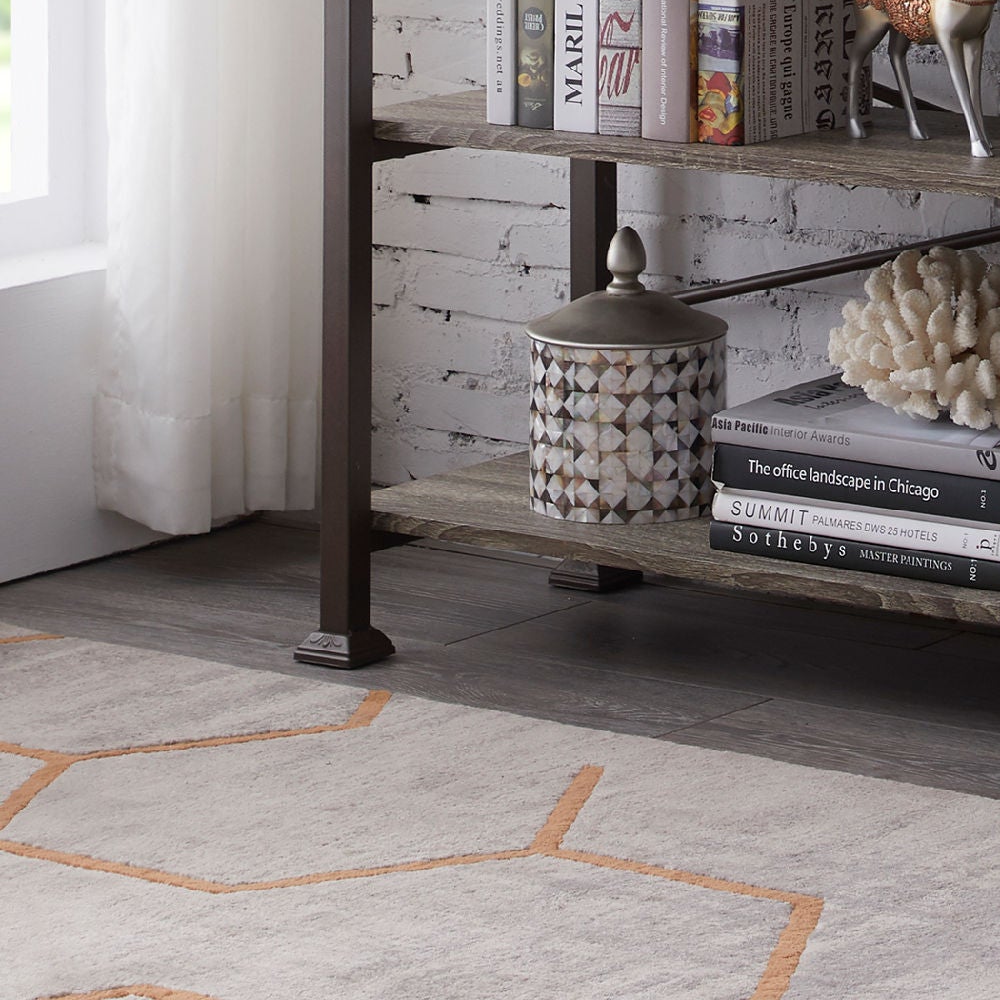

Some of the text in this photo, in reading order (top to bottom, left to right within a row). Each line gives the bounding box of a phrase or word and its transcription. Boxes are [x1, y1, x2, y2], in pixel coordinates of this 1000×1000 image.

[660, 28, 668, 56] Review
[660, 58, 668, 68] of
[780, 57, 796, 77] qui
[659, 97, 667, 125] Design
[780, 81, 794, 121] gagne
[711, 417, 851, 446] Asia Pacific Interior Awards
[748, 459, 939, 501] The office landscape in Chicago
[730, 500, 938, 542] SUMMIT PALMARES DWS 25 HOTELS
[732, 525, 952, 571] Sothebys MASTER PAINTINGS
